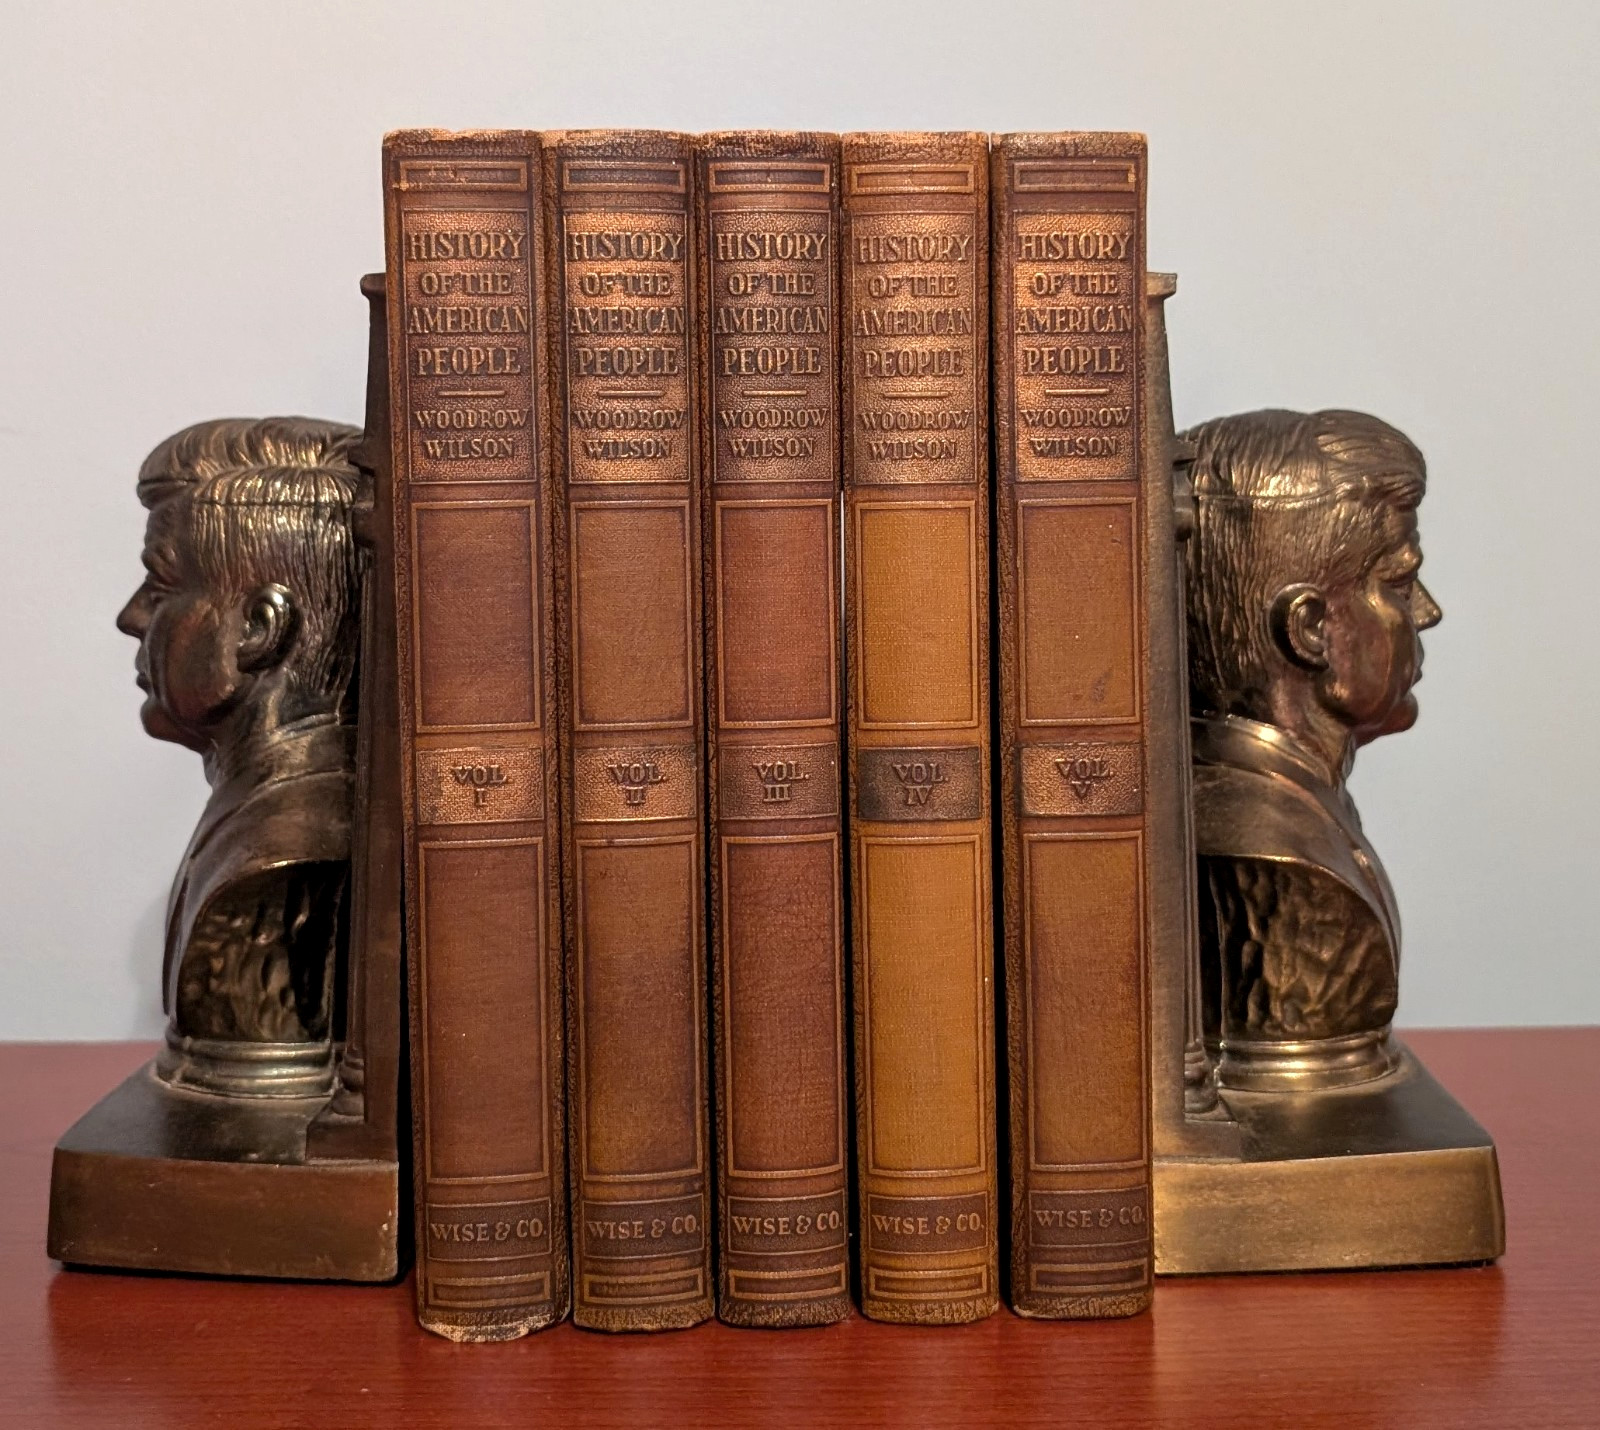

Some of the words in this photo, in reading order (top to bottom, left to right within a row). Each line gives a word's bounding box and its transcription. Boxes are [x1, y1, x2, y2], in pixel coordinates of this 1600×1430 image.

[408, 230, 526, 260] HISTORY
[569, 231, 684, 261] HISTORY
[716, 232, 827, 261] HISTORY
[856, 234, 972, 263] HISTORY
[1017, 231, 1132, 261] HISTORY
[421, 273, 459, 295] OF
[463, 272, 512, 295] THE
[583, 273, 615, 296] OF
[618, 273, 672, 296] THE
[728, 272, 759, 295] OF
[768, 272, 815, 295] THE
[868, 275, 899, 297] OF
[910, 274, 958, 297] THE
[1030, 272, 1061, 295] OF
[1069, 272, 1119, 295] THE
[408, 306, 529, 334] AMERICAN
[570, 307, 686, 334] AMERICAN
[714, 307, 828, 334] AMERICAN
[855, 308, 973, 336] AMERICAN
[1016, 305, 1132, 334] AMERICAN
[417, 347, 521, 376] PEOPLE
[577, 347, 679, 376] PEOPLE
[722, 347, 822, 375] PEOPLE
[864, 348, 964, 377] PEOPLE
[1023, 345, 1126, 375] PEOPLE
[415, 409, 528, 429] WOODROW
[574, 409, 686, 430] WOODROW
[720, 408, 828, 429] WOODROW
[861, 410, 971, 431] WOODROW
[1021, 407, 1131, 428] WOODROW
[425, 437, 514, 459] WILSON
[583, 438, 674, 460] WILSON
[729, 437, 814, 458] WILSON
[870, 439, 957, 460] WILSON
[1030, 436, 1118, 458] WILSON
[608, 762, 668, 783] VOL.
[753, 760, 810, 781] VOL.
[475, 788, 487, 806] I
[625, 786, 646, 805] II
[763, 783, 790, 803] III
[905, 784, 933, 806] IV
[1071, 781, 1090, 799] V
[586, 1220, 646, 1240] WISE
[650, 1218, 666, 1238] &
[731, 1215, 791, 1236] WISE
[796, 1214, 812, 1235] &
[871, 1213, 929, 1235] WISE
[935, 1214, 951, 1235] &
[1033, 1209, 1092, 1229] WISE
[1098, 1209, 1112, 1228] &
[430, 1222, 490, 1242] WISE
[495, 1221, 511, 1241] &
